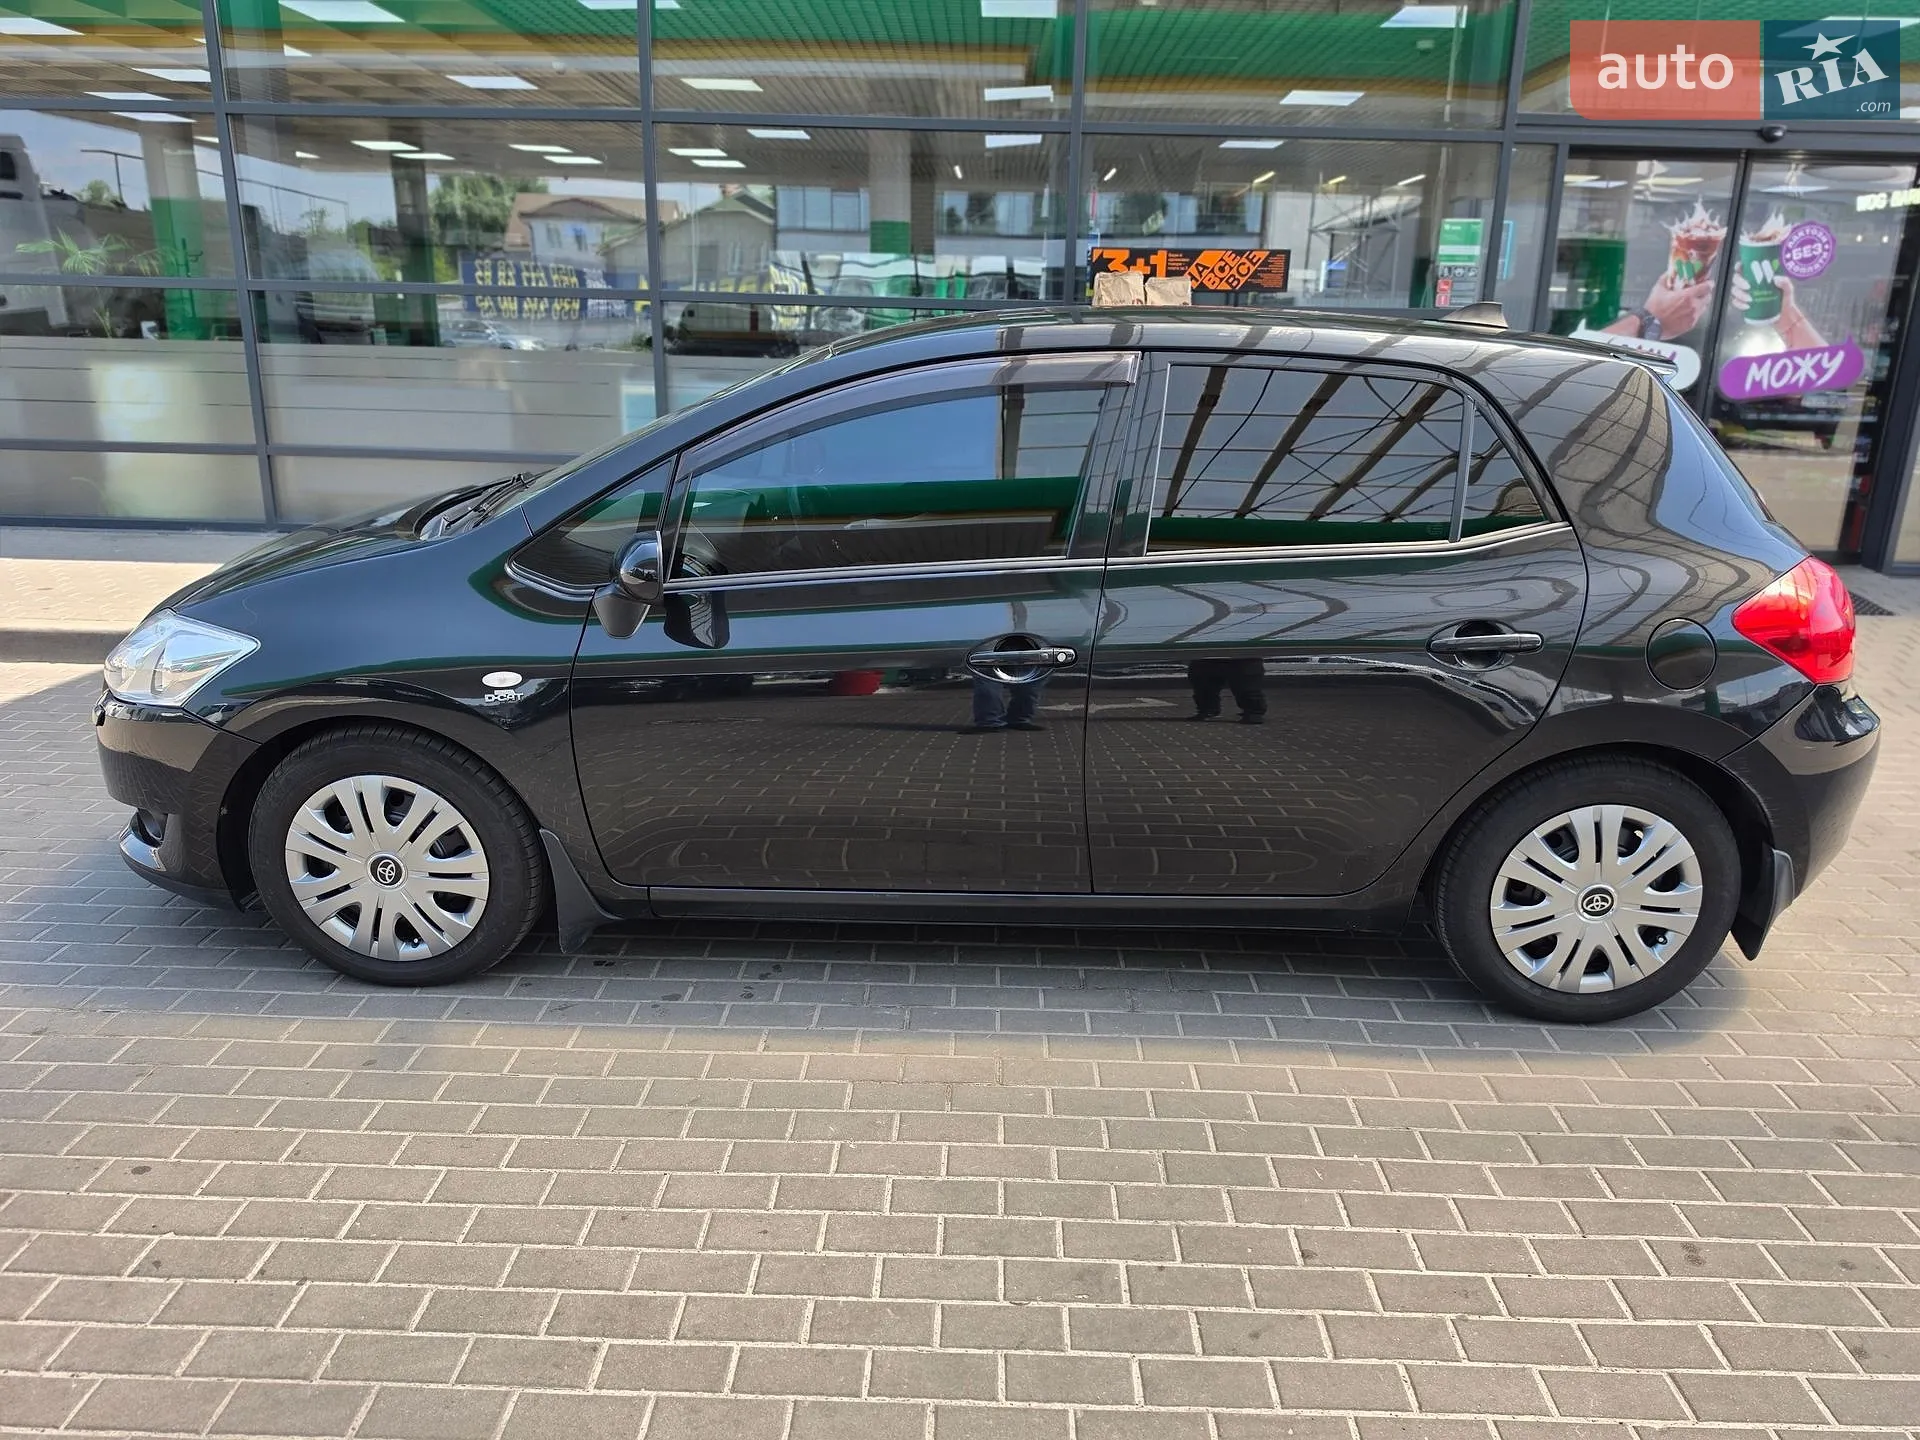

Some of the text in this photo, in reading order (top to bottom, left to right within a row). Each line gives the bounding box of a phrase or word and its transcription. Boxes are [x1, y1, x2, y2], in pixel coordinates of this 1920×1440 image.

[1103, 249, 1167, 278] 3+1
[1202, 250, 1240, 289] ВСЕ
[1225, 250, 1262, 289] ВСЕ
[1792, 243, 1822, 260] БЕЗ
[1745, 350, 1845, 393] МОЖУ
